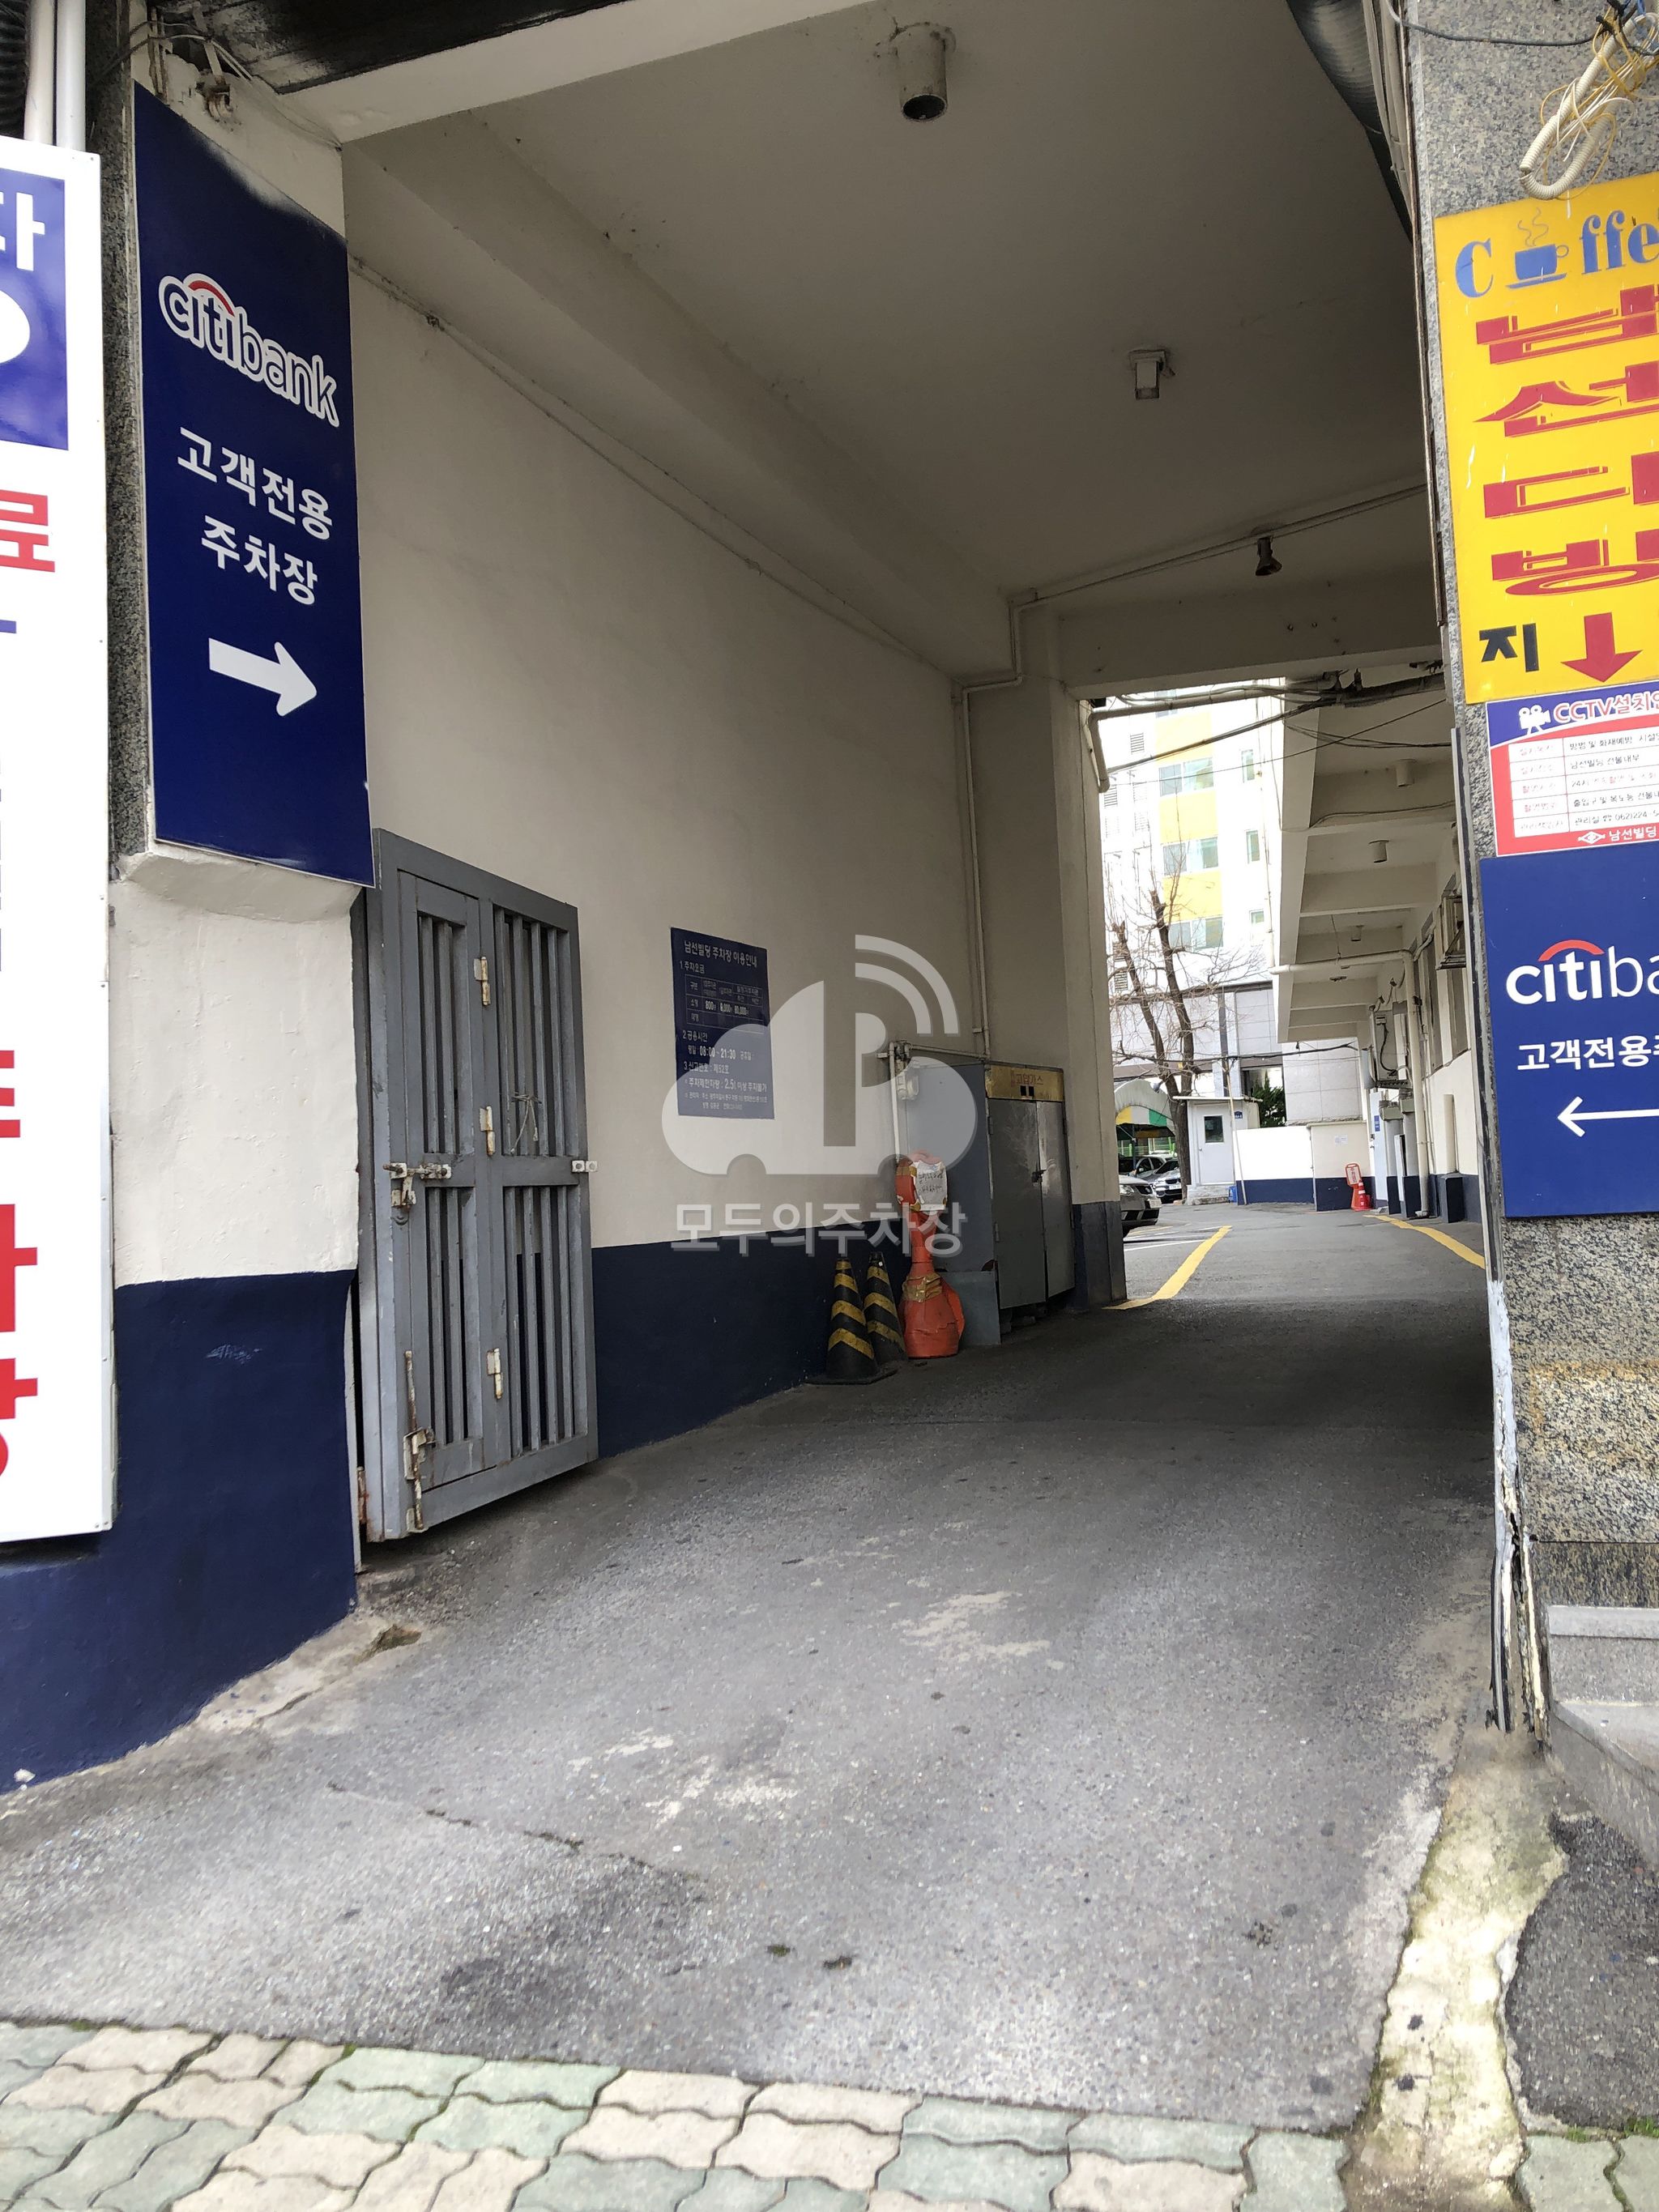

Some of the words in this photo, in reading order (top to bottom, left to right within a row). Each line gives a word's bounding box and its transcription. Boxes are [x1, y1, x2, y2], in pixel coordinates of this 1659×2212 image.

[158, 273, 339, 427] citibank
[177, 426, 332, 540] 고객전용
[201, 514, 318, 606] 주차장
[1478, 623, 1539, 672] 지
[1609, 825, 1657, 842] 남선빌딩
[684, 940, 711, 958] 남선빌딩
[713, 946, 731, 963] 주차장
[733, 952, 757, 968] 이용안내
[1517, 1035, 1659, 1070] 고객전용
